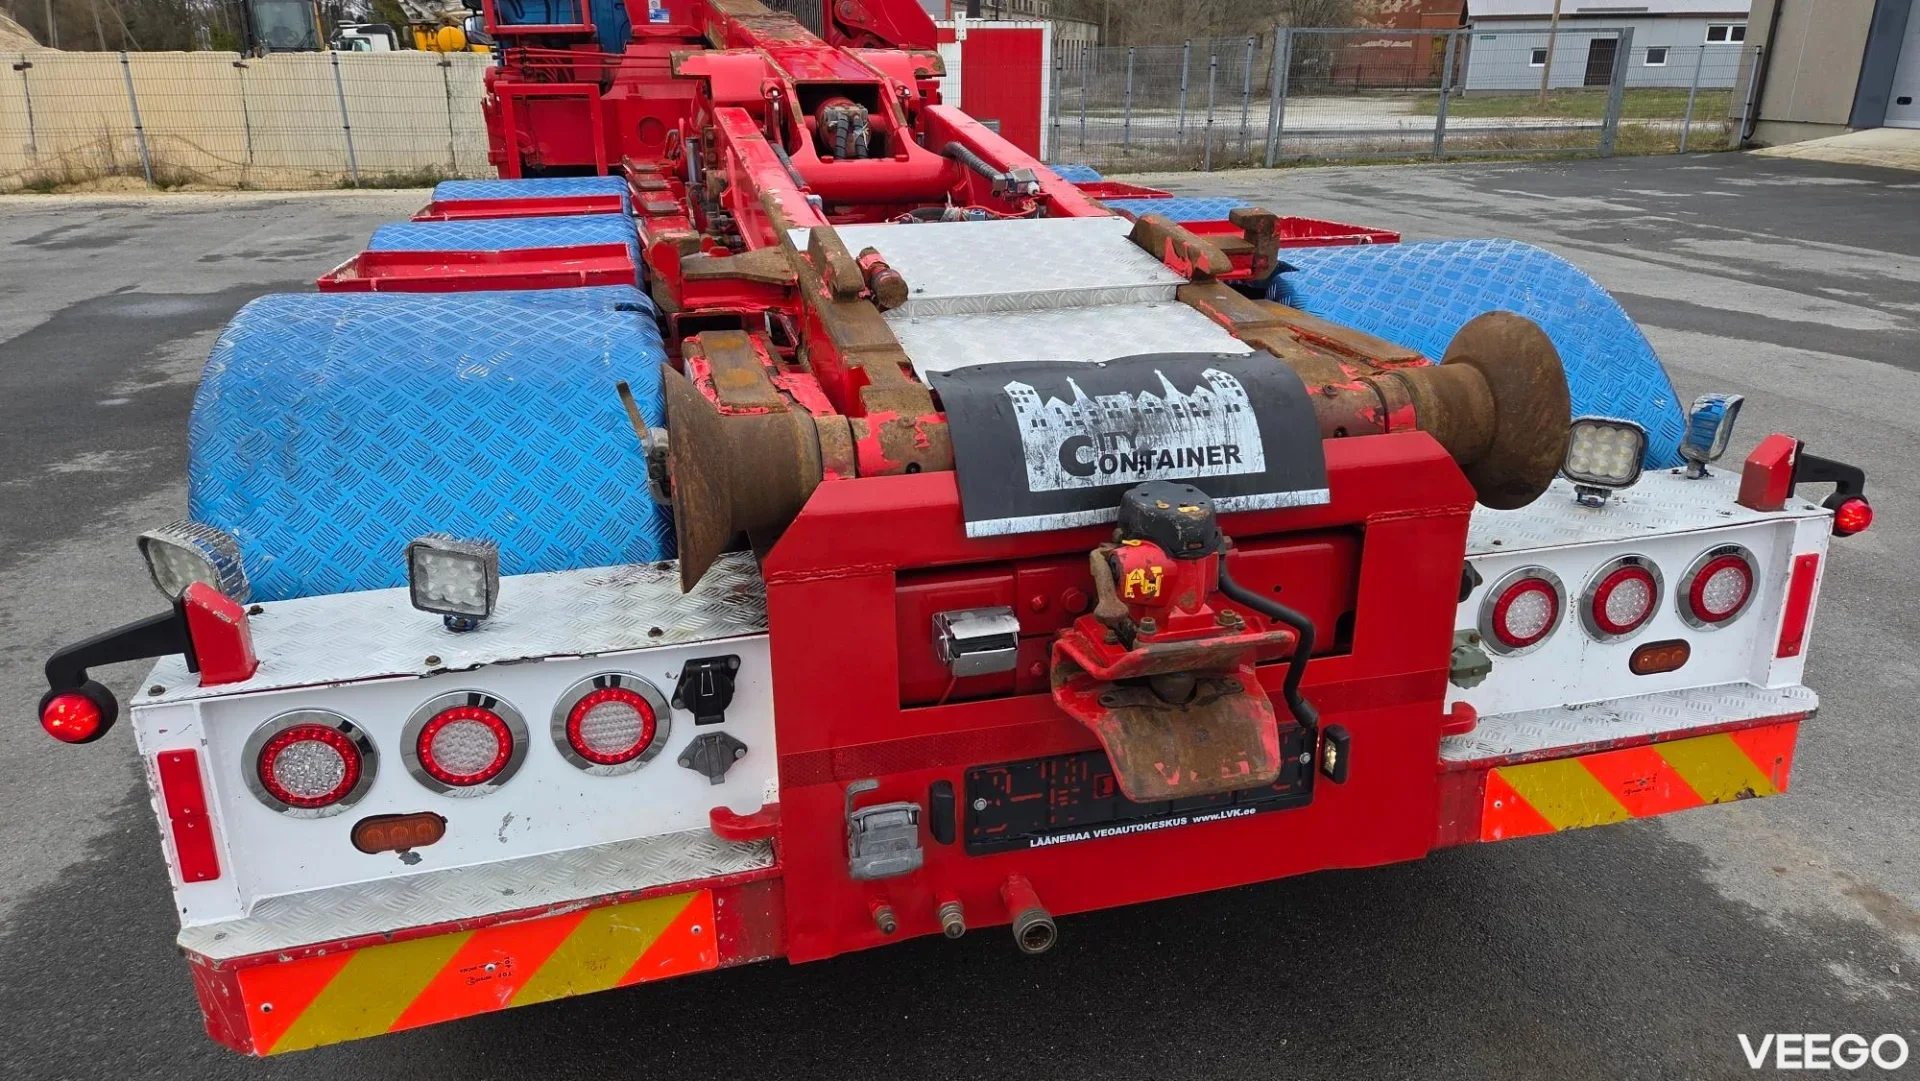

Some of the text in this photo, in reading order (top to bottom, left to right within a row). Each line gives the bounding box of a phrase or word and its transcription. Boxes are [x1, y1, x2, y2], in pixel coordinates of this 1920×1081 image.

[1030, 807, 1256, 848] LÄÄNEMAA VEOAUTOKESKUS www.LVK.ee
